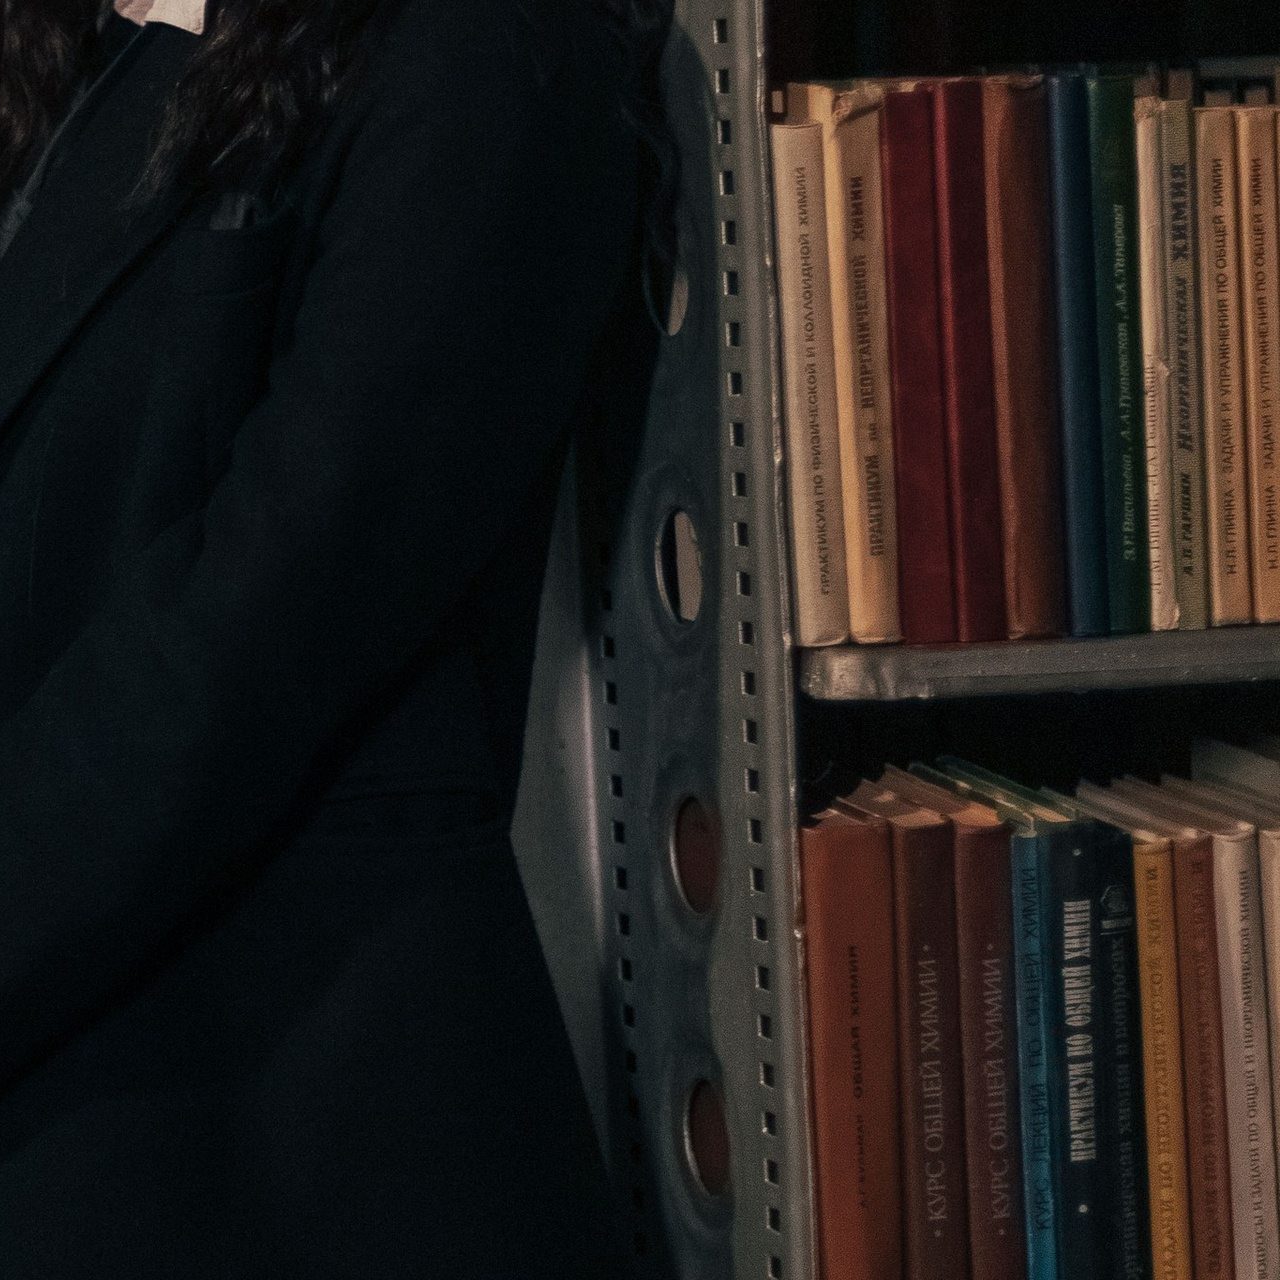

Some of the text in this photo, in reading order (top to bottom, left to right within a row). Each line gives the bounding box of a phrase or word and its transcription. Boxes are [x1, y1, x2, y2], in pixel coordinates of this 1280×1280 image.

[850, 176, 867, 242] ХИМИИ
[1170, 162, 1189, 262] ХИМИЯ
[1211, 158, 1224, 208] ХИМИИ
[1250, 157, 1264, 207] ХИМИИ
[1212, 215, 1230, 270] ОБЩЕЙ
[1251, 213, 1268, 268] ОБЩЕЙ
[1216, 273, 1228, 294] ПО
[1254, 271, 1267, 292] ПО
[851, 255, 876, 410] НЕОРГАНИЧЕСКОЙ
[1216, 298, 1232, 396] УПРАЖНЕНИЯ
[1256, 296, 1273, 393] УПРАЖНЕНИЯ
[795, 166, 830, 595] ПРАКТИКУМ ПО ФИЗИЧЕСКОЙ И КОЛЛОИДНОЙ ХИМИИ
[1221, 402, 1231, 412] И
[1262, 398, 1272, 409] И
[1219, 418, 1235, 475] ЗАДАЧИ
[1261, 415, 1276, 470] ЗАДАЧИ
[864, 454, 885, 557] ПРАКТИКУМ
[1179, 472, 1193, 543] ГАРШИН
[1145, 866, 1163, 949] ХИМИИ
[847, 945, 861, 1017] ХИМИЯ
[1110, 936, 1131, 1039] вопросах
[850, 1026, 863, 1099] ОБЩАЯ
[1020, 867, 1051, 1231] КУРС ЛЕКЦИЙ ПО ОБЩЕЙ ХИМИИ
[1061, 899, 1097, 1163] ПРАКТИКУМ ПО ОБЩЕЙ ХИМИИ
[1147, 957, 1172, 1156] НЕОРГАНИЧЕСКОЙ
[917, 958, 948, 1221] КУРС ОБЩЕЙ ХИМИИ
[981, 958, 1011, 1220] КУРС ОБЩЕЙ ХИМИИ
[1116, 1063, 1132, 1135] химия
[1237, 869, 1269, 1280] ВОПРОСЫ И ЗАДАЧИ ПО ОБЩЕЙ И НЕОРГАНИЧЕСКОЙ ХИМИИ
[1157, 1160, 1173, 1189] ПО
[1201, 1153, 1217, 1181] ПО
[1203, 1190, 1223, 1275] ЗАДАЧИ
